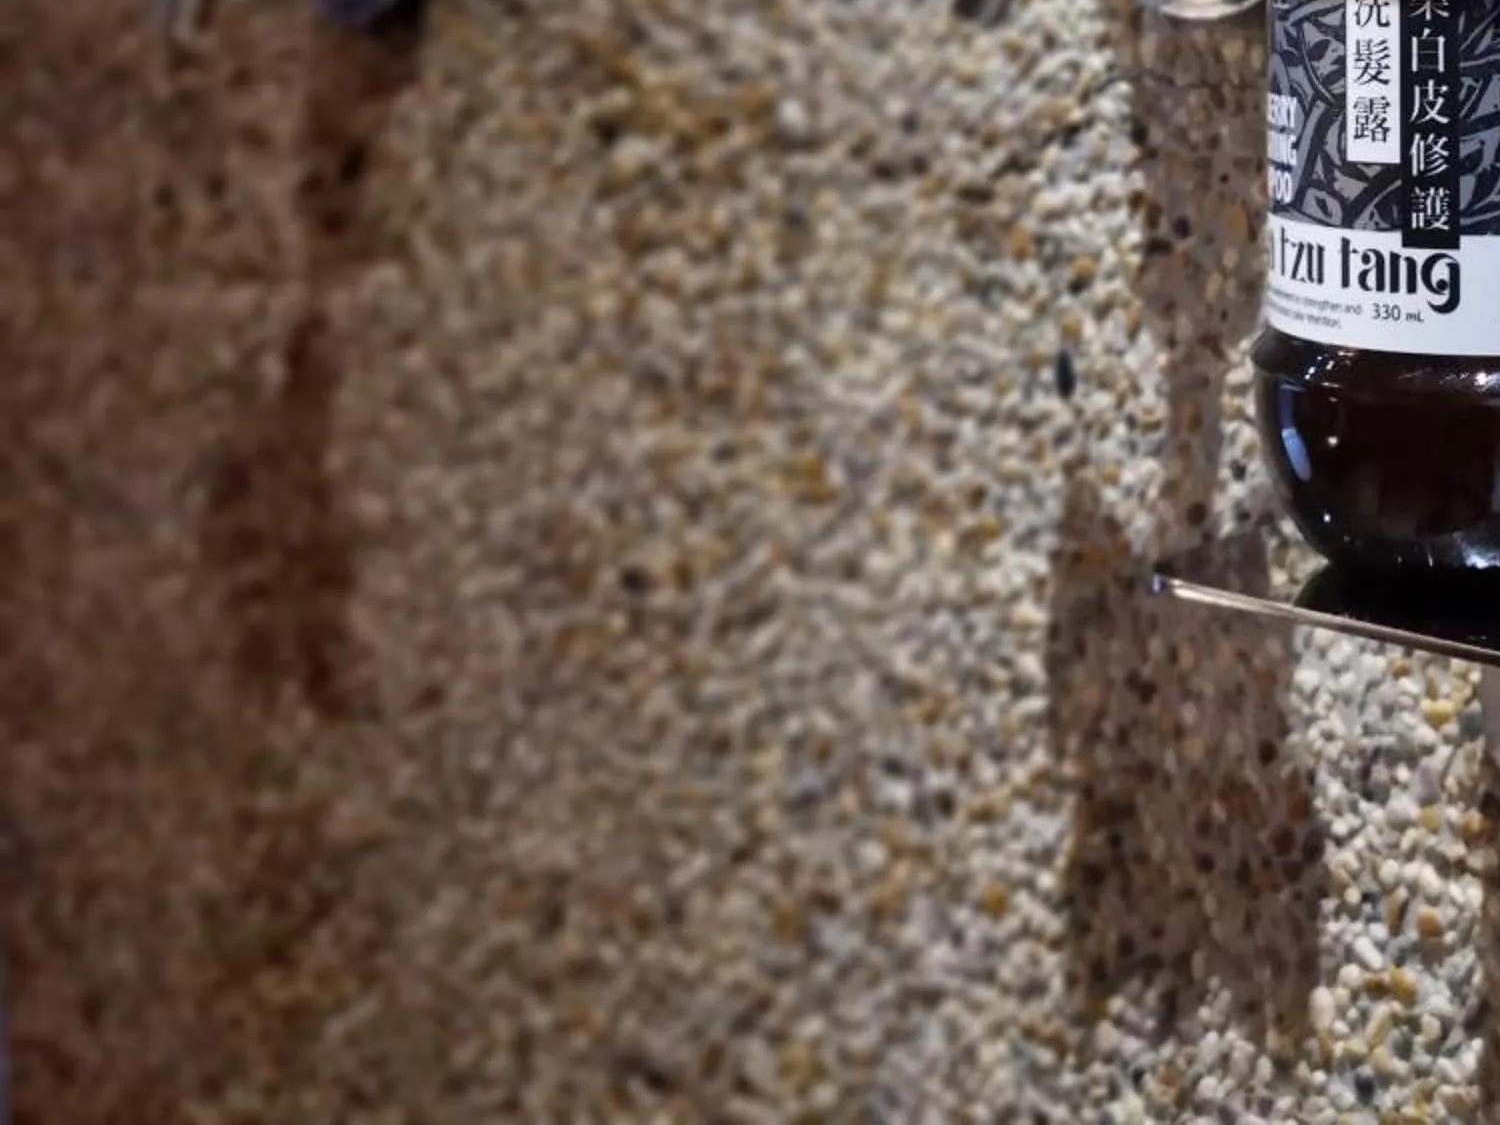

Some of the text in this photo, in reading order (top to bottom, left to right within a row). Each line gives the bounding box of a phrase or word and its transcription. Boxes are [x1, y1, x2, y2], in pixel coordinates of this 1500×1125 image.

[1281, 226, 1325, 285] tzu
[1339, 236, 1461, 314] tang
[1372, 302, 1424, 322] 330 mL
